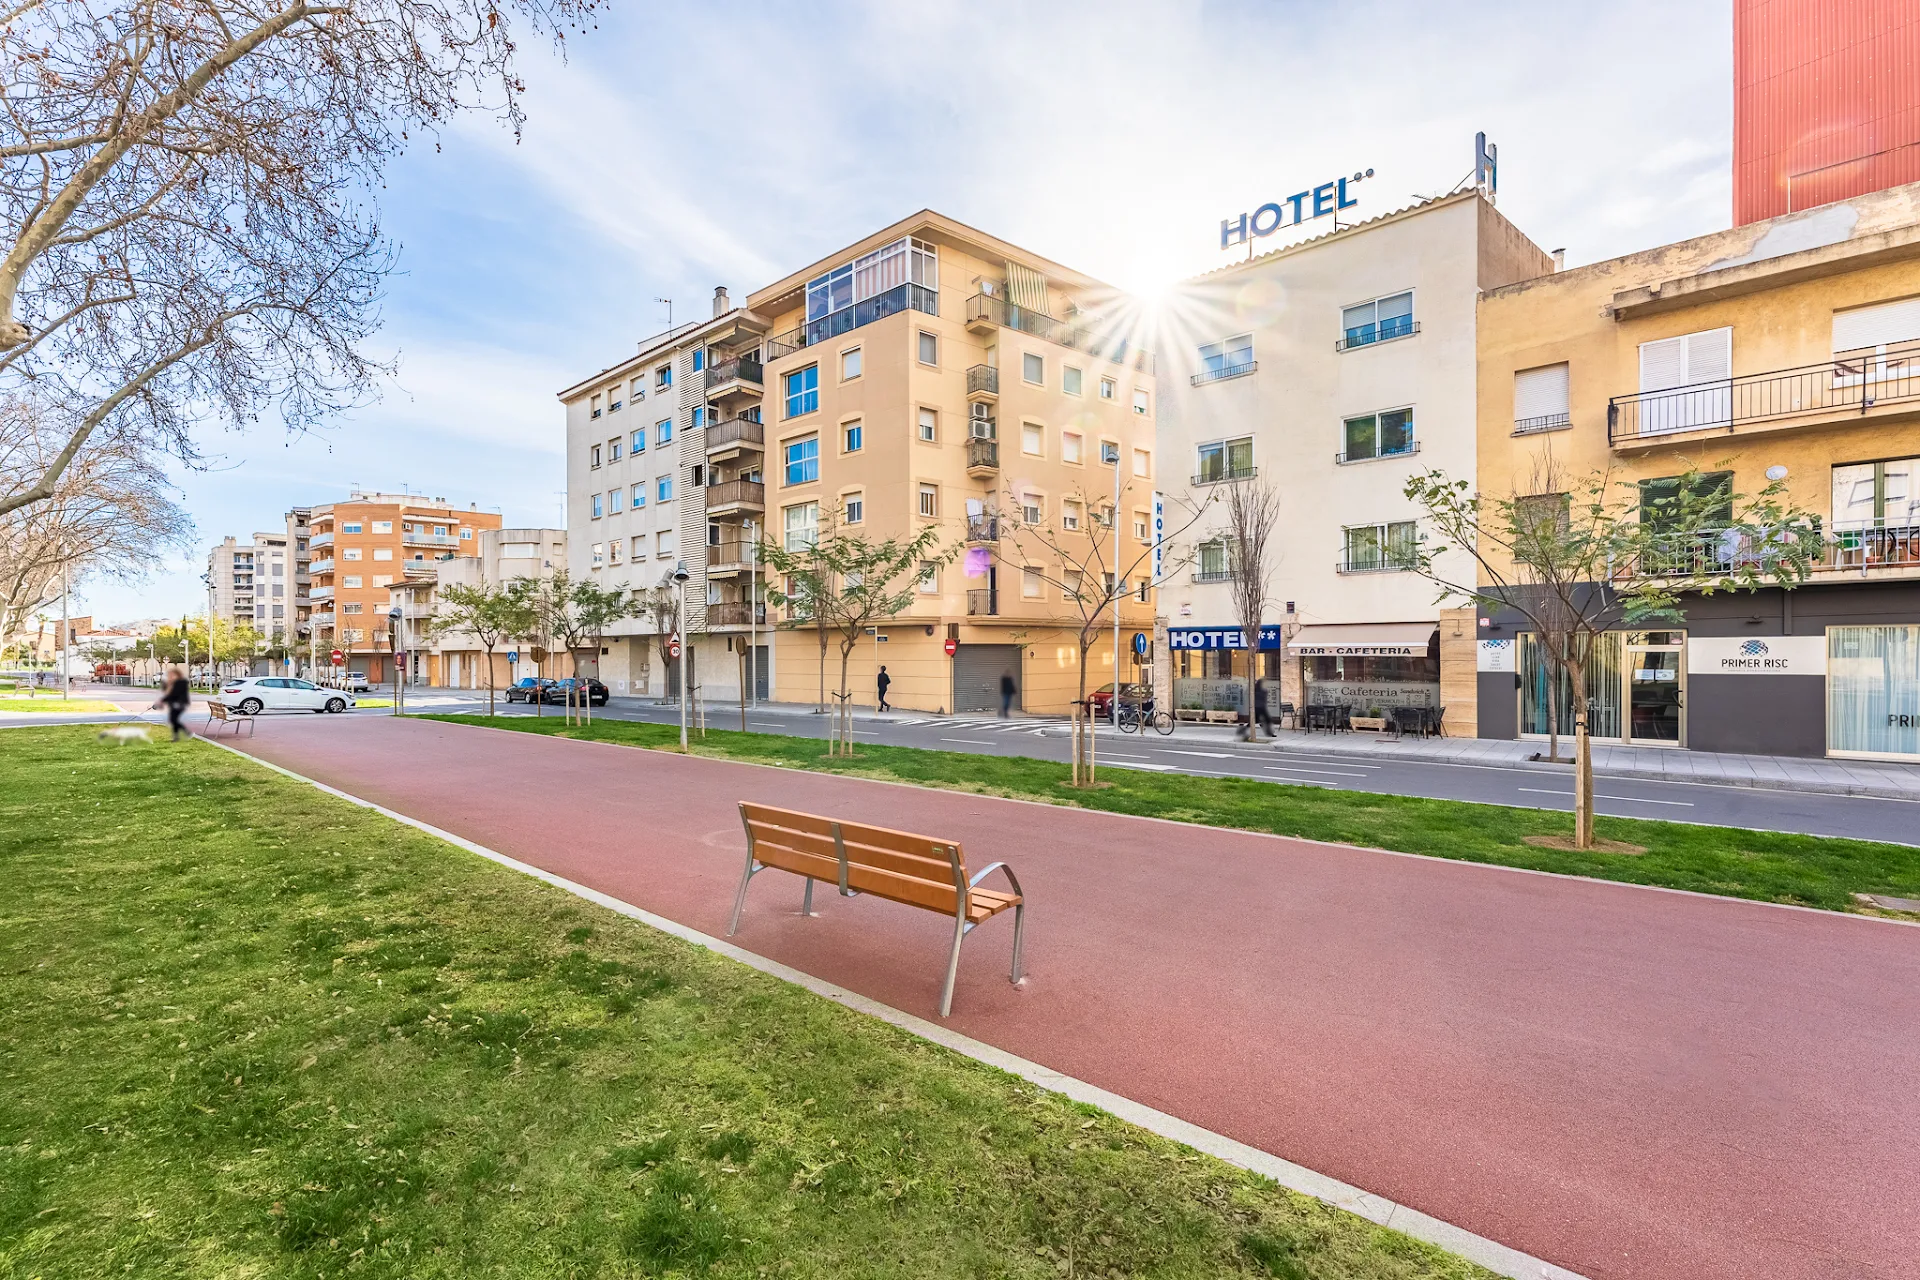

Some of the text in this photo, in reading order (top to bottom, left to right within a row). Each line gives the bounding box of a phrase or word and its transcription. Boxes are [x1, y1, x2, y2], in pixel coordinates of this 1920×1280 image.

[1220, 177, 1358, 250] HOTEL
[1300, 647, 1412, 655] BAR CAFETERIA
[1721, 658, 1789, 669] PRIMER RISC
[1202, 683, 1220, 692] Bar
[1317, 686, 1339, 694] Beer
[1341, 686, 1398, 697] Cafeteria
[1887, 714, 1920, 728] PRI
